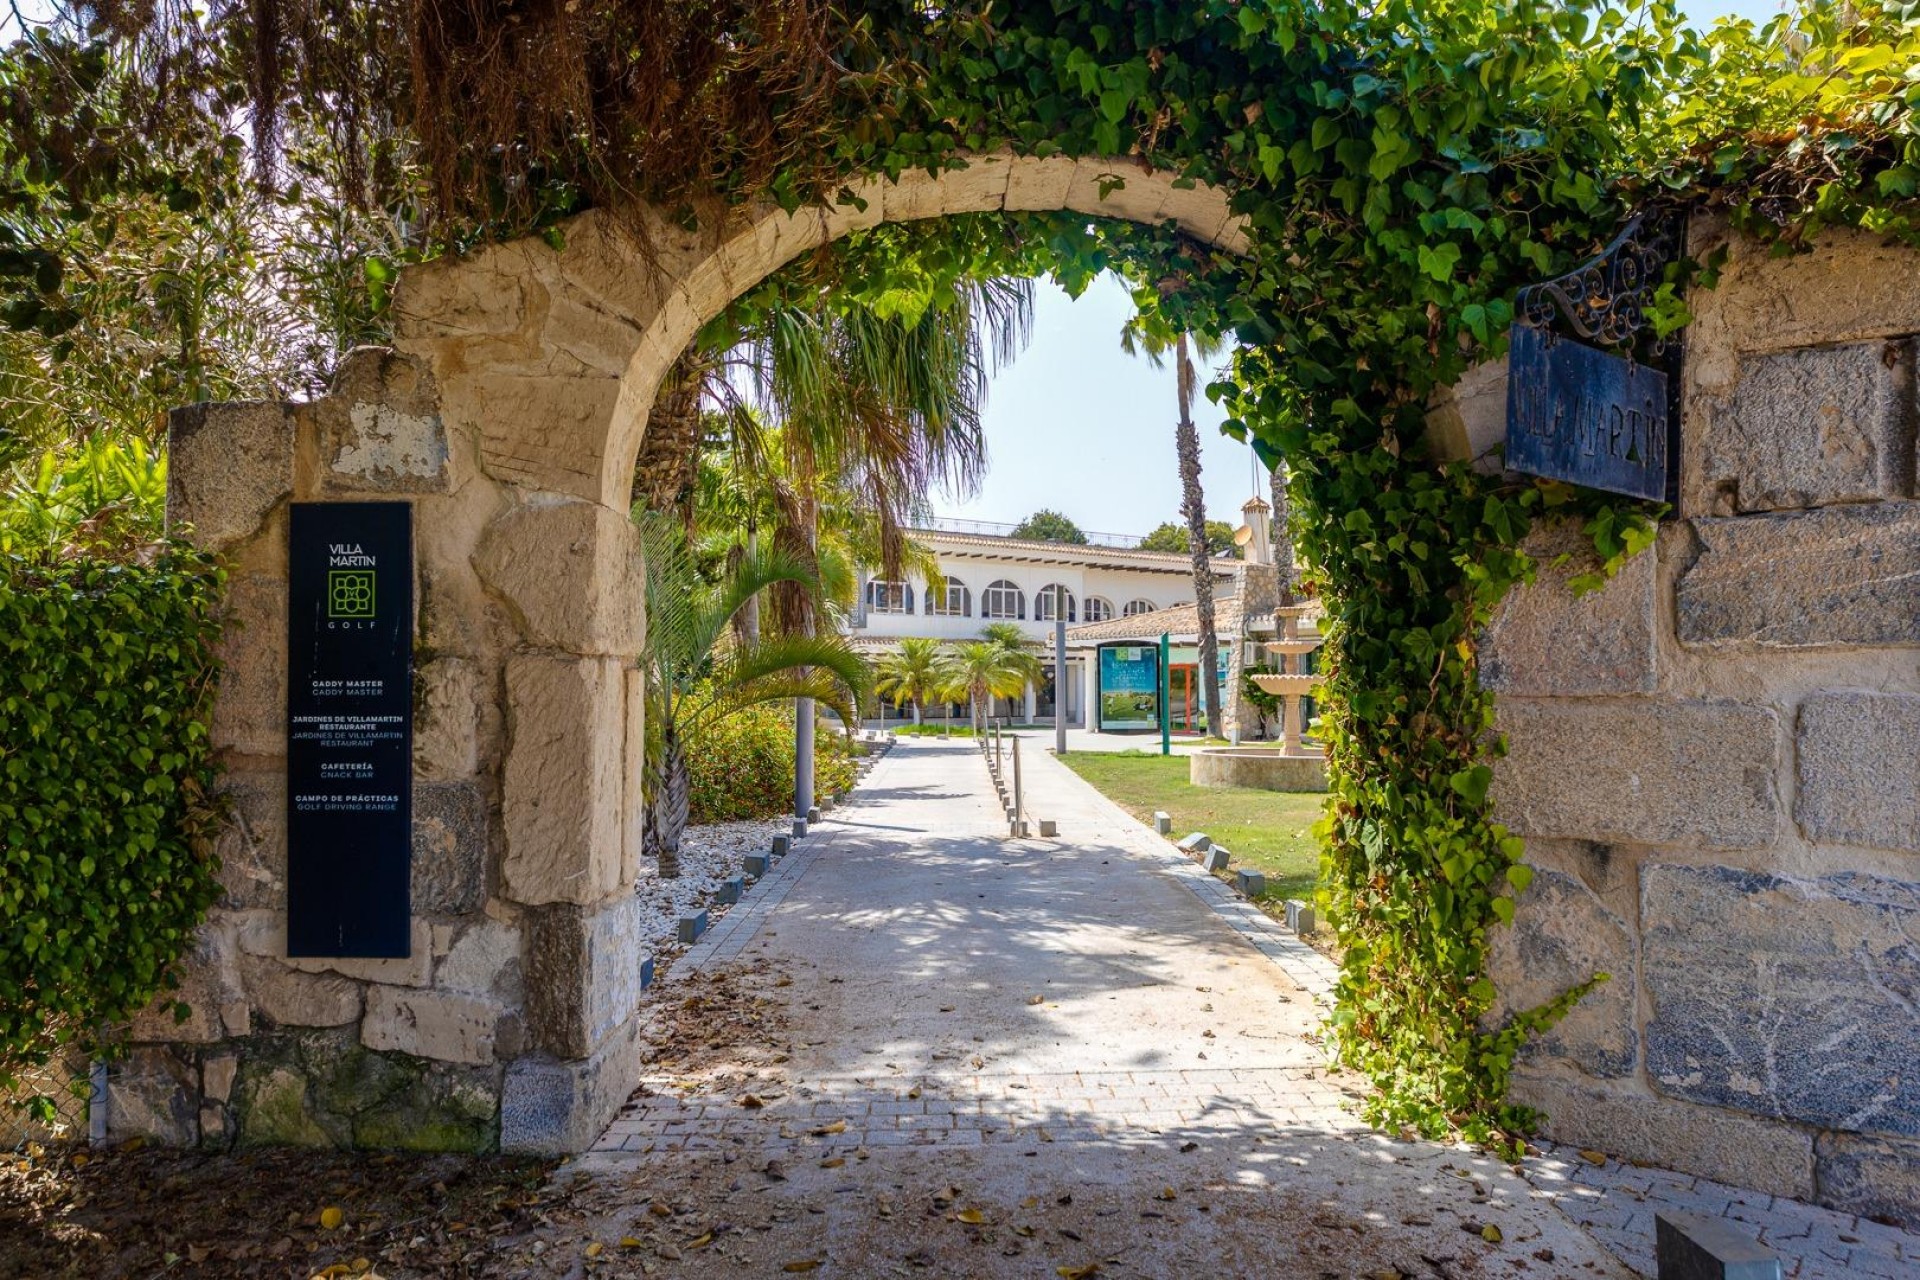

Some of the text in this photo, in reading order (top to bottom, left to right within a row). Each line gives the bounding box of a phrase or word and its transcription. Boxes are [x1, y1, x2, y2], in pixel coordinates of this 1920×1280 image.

[329, 543, 363, 554] VILLA
[329, 556, 376, 566] MARTIN
[321, 762, 373, 770] CAFETERÍA
[345, 793, 399, 802] PRÁCTICAS
